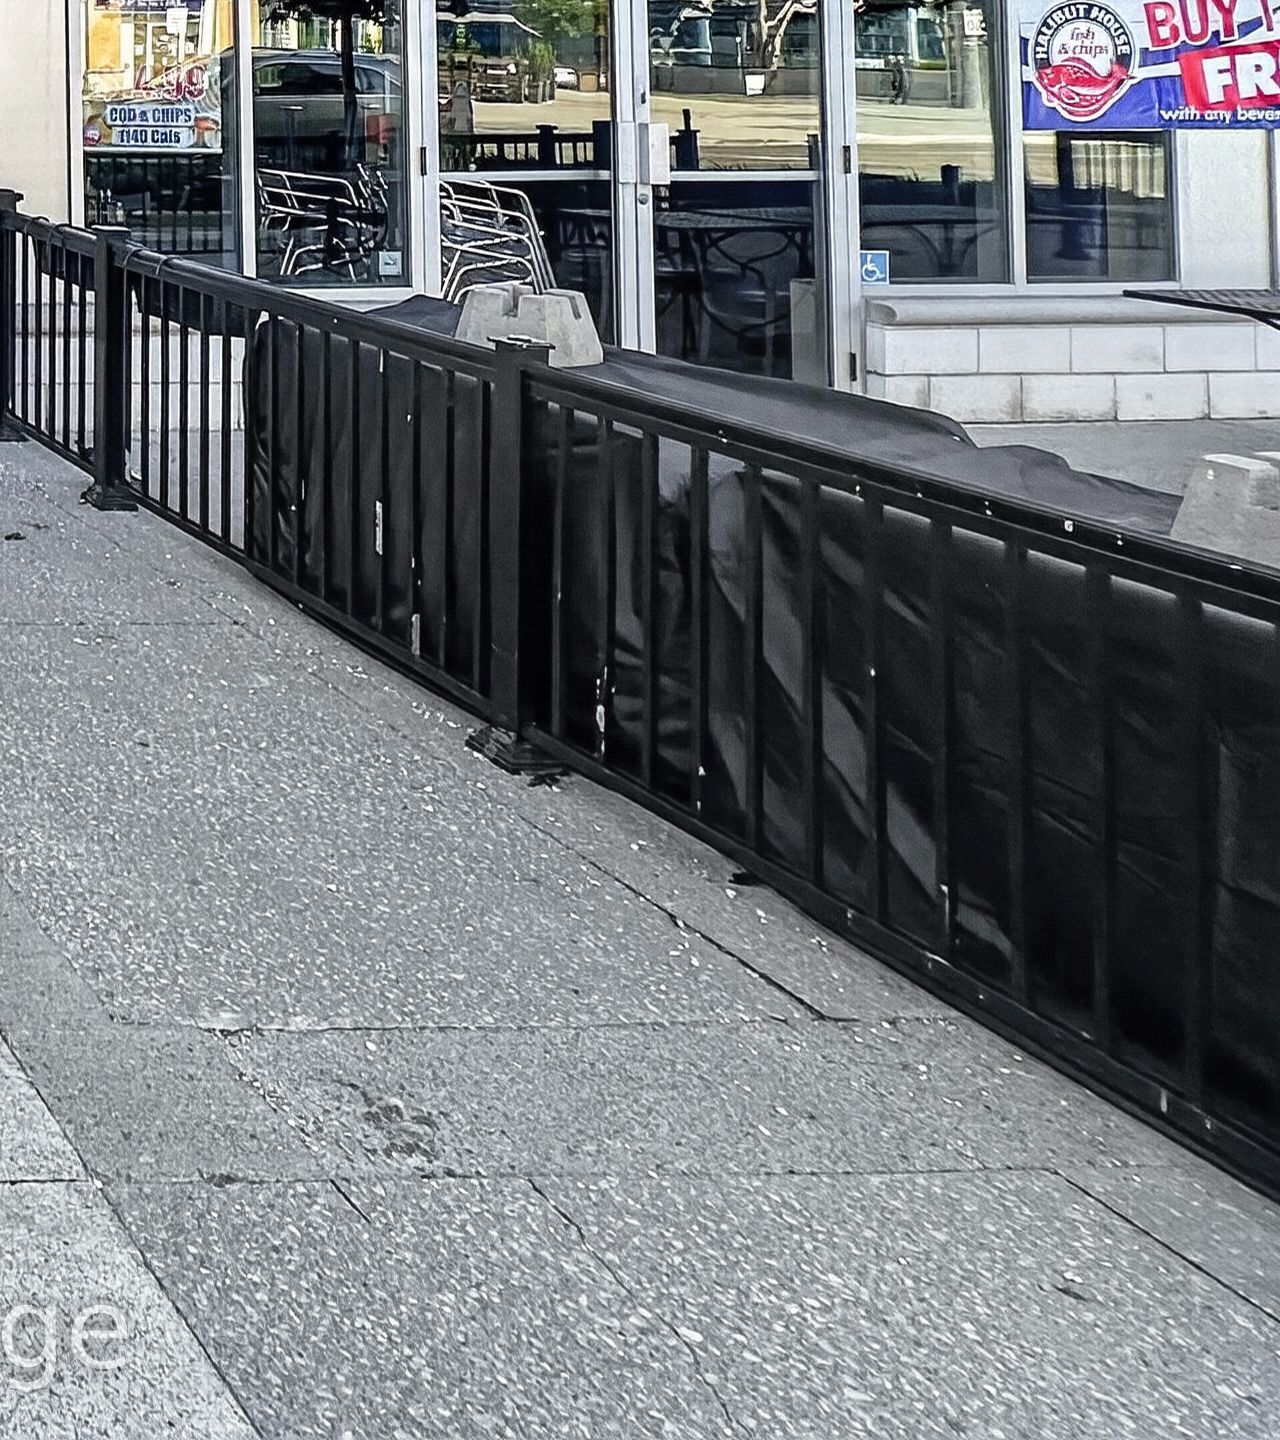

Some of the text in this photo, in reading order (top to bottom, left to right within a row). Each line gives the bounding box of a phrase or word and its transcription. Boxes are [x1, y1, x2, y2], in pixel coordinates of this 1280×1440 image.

[1035, 4, 1130, 59] HALIBUT HOUSE
[1202, 51, 1280, 103] FR
[152, 107, 192, 123] CHIPS
[1160, 106, 1201, 121] with
